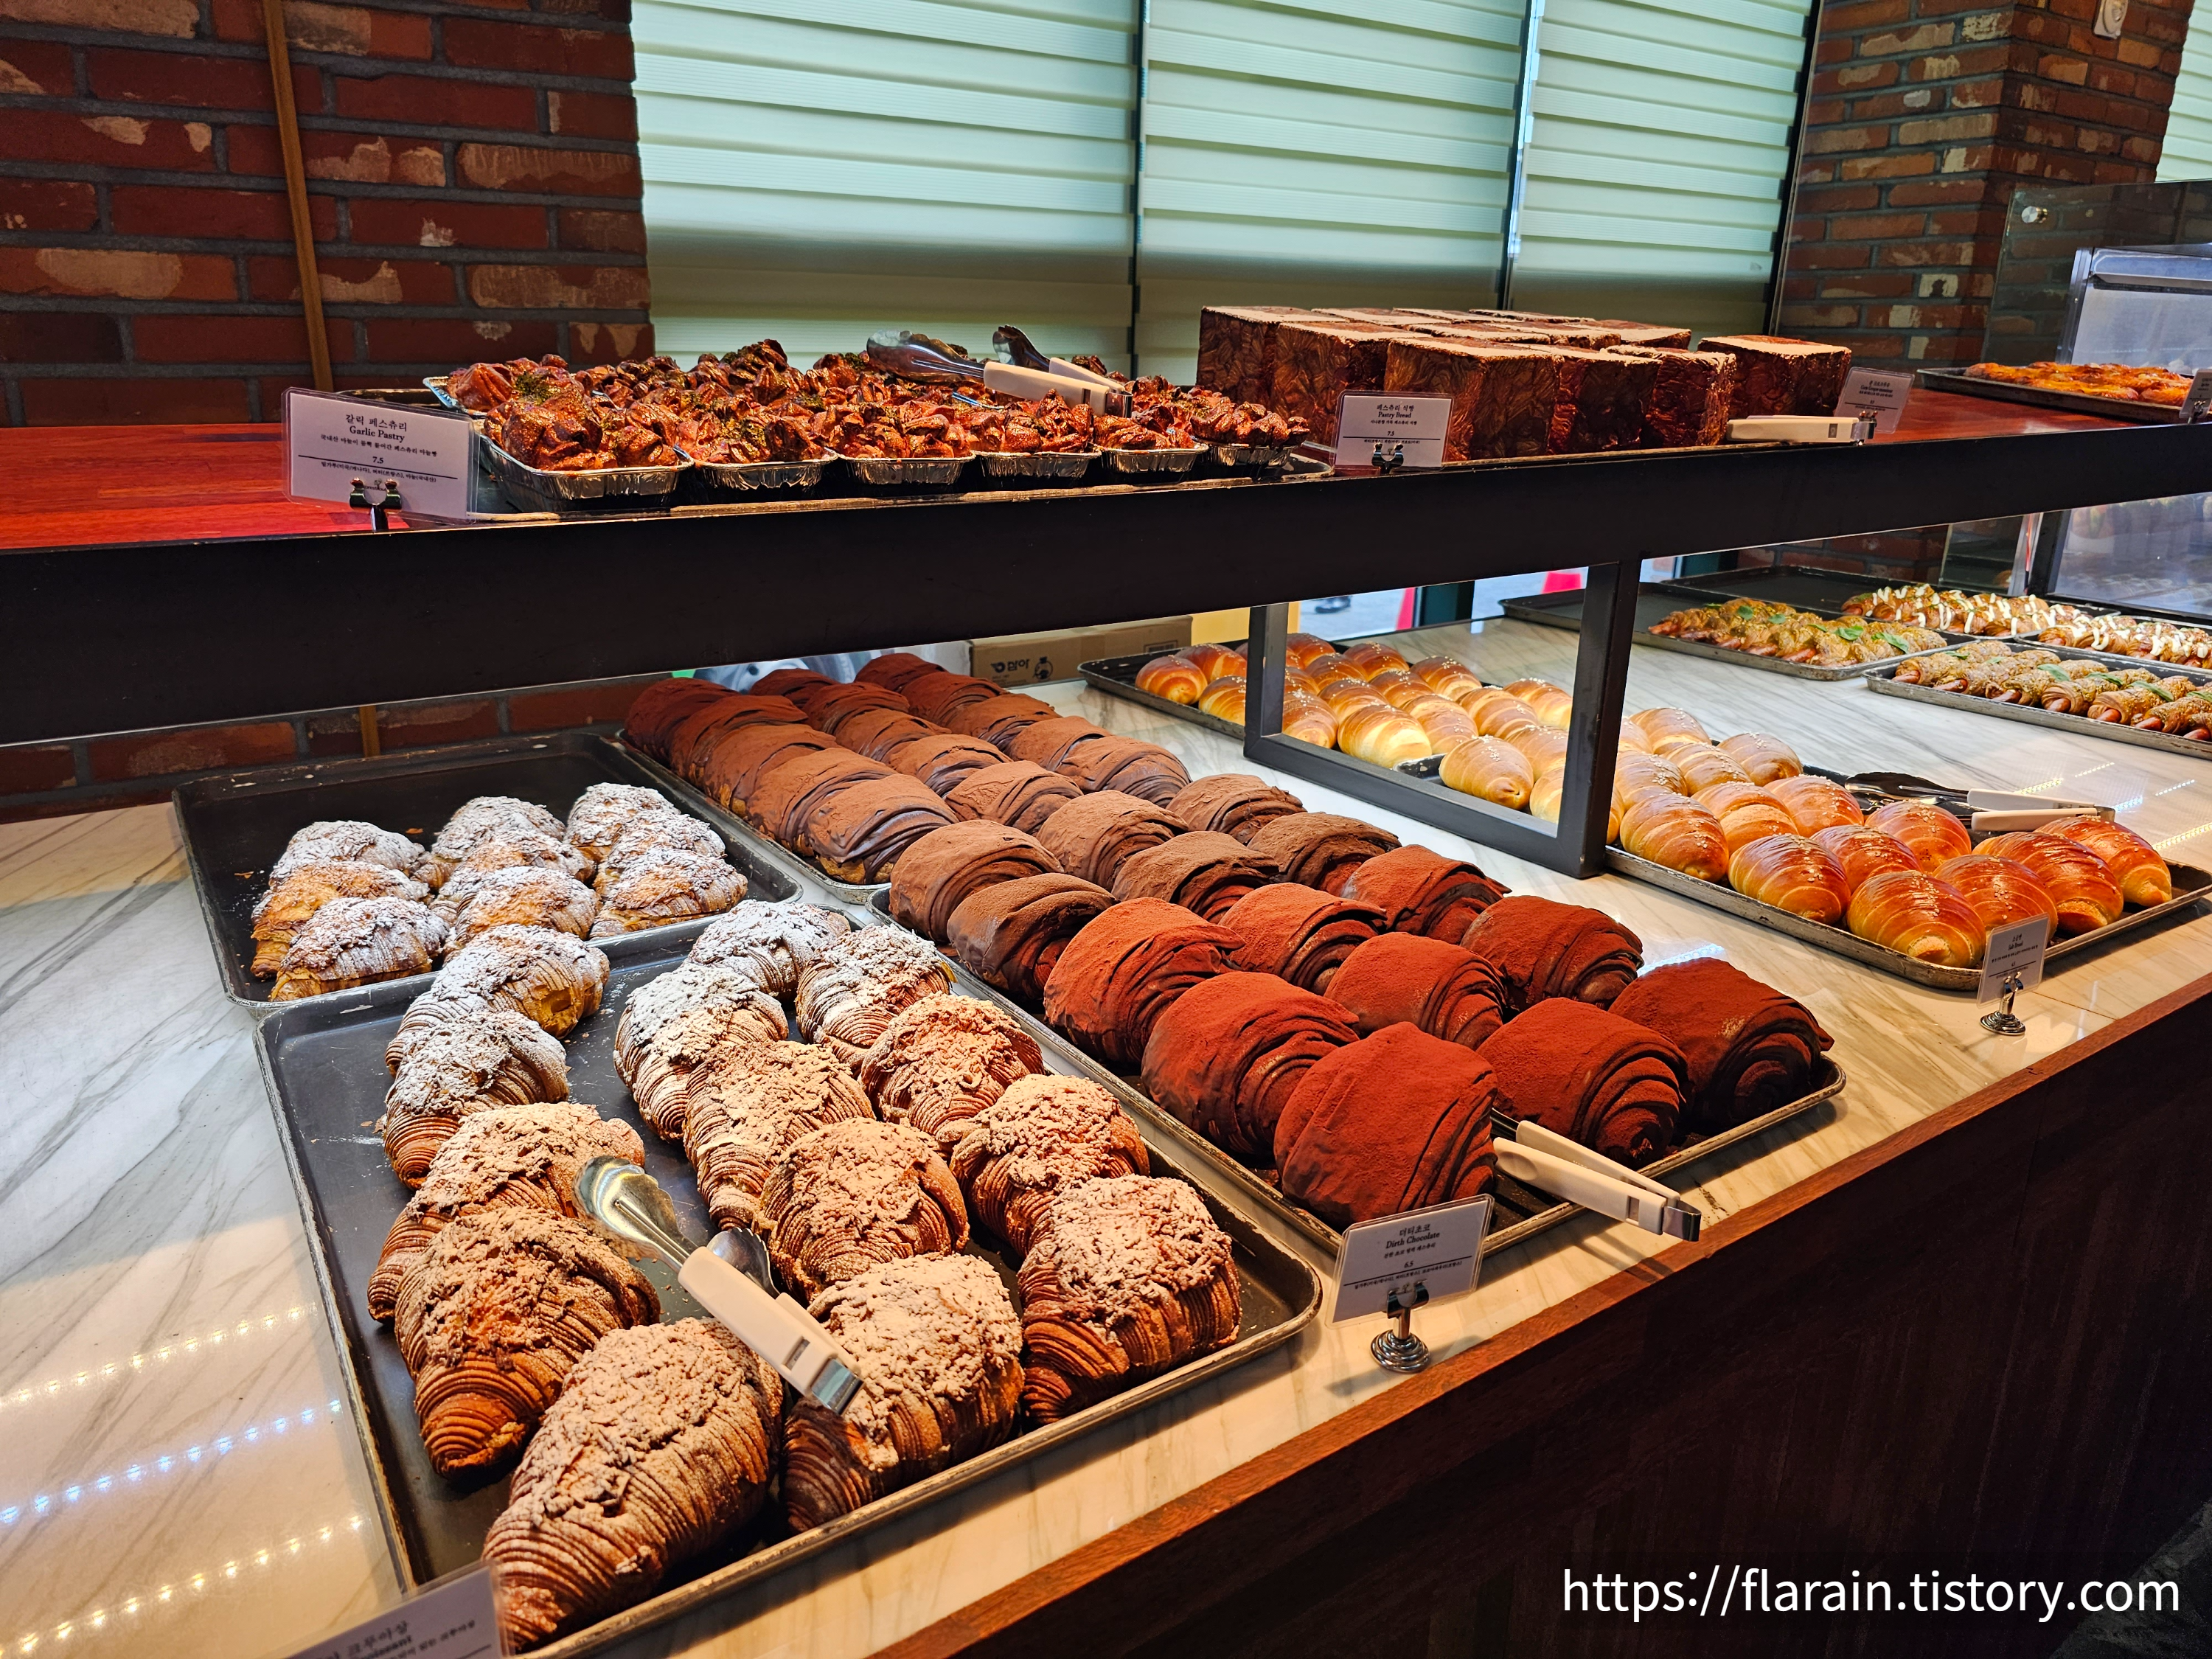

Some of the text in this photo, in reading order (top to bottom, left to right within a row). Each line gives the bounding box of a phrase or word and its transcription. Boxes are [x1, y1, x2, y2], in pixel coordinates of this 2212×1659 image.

[346, 414, 407, 432] 갈릭 페스츄리
[349, 425, 406, 443] Garlic Pastry
[321, 434, 338, 442] 국내산
[341, 437, 358, 445] 마늘이
[375, 442, 392, 451] 들어간
[394, 445, 417, 455] 페스츄리
[420, 448, 437, 457] 마늘빵
[372, 456, 384, 464] 7.5
[1399, 1224, 1431, 1237] 더티초코
[1406, 1232, 1440, 1244] Chocolate
[1404, 1260, 1413, 1268] 6.5
